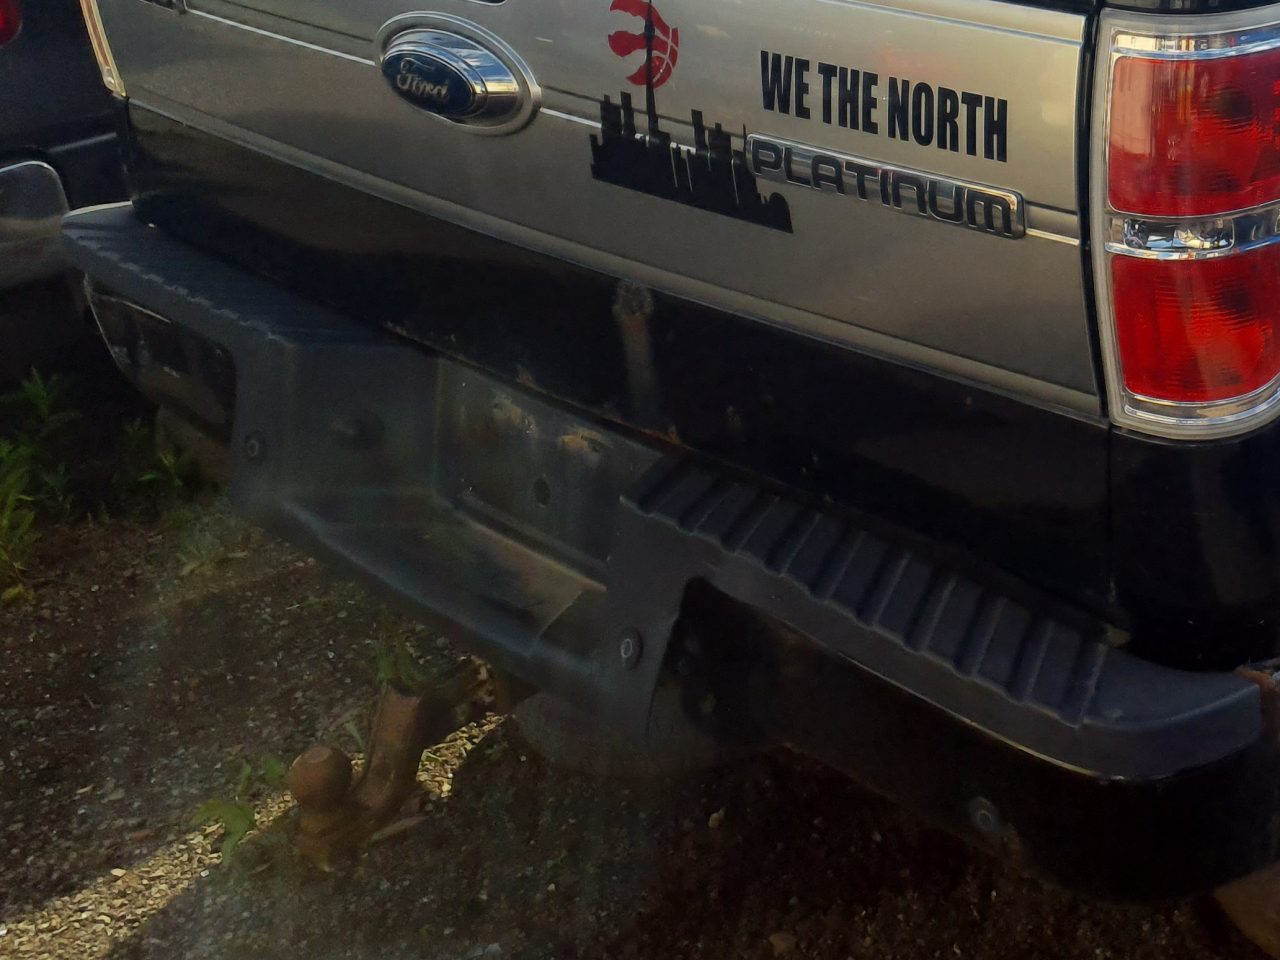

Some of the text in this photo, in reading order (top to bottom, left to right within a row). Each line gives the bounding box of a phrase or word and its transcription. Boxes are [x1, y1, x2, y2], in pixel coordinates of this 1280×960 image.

[396, 57, 449, 97] Ford
[760, 50, 1008, 163] WE THE NORTH
[751, 139, 1014, 237] PLATINUM
